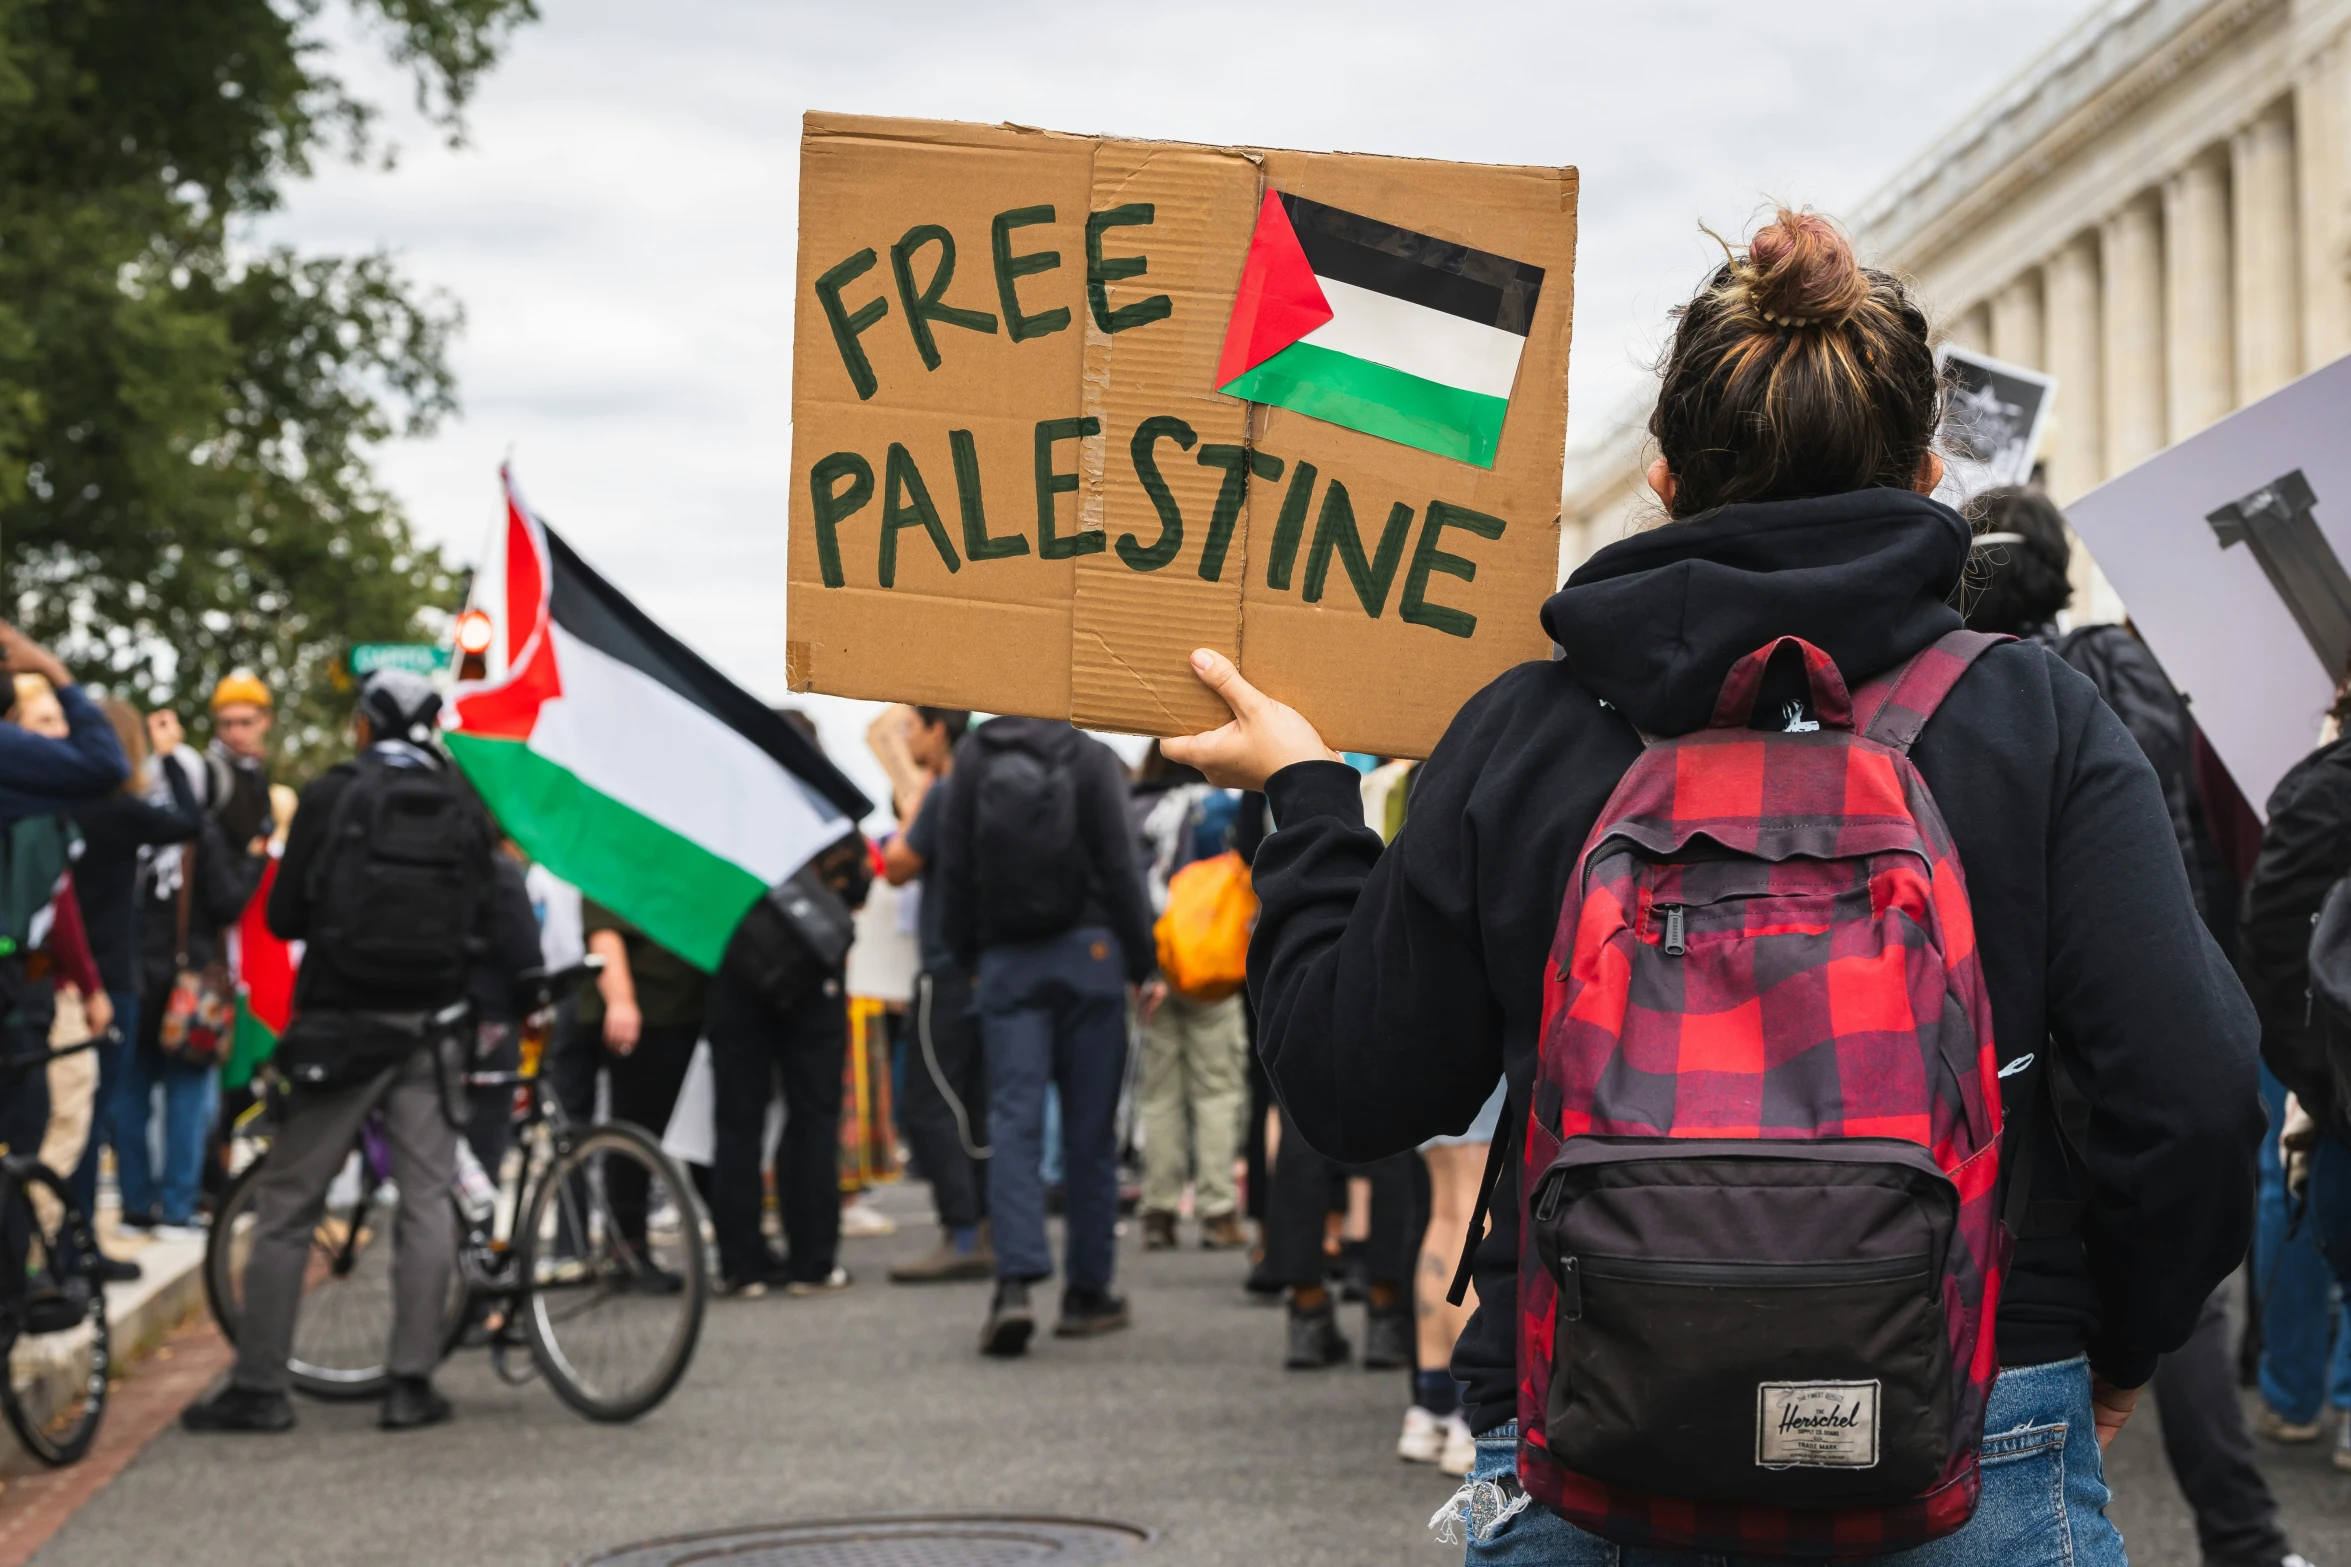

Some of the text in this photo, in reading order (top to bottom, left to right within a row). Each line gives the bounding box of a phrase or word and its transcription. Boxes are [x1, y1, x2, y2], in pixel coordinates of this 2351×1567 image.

[815, 203, 1172, 400] FREE
[810, 415, 1507, 638] PALESTINE
[1778, 1401, 1860, 1435] Herschel
